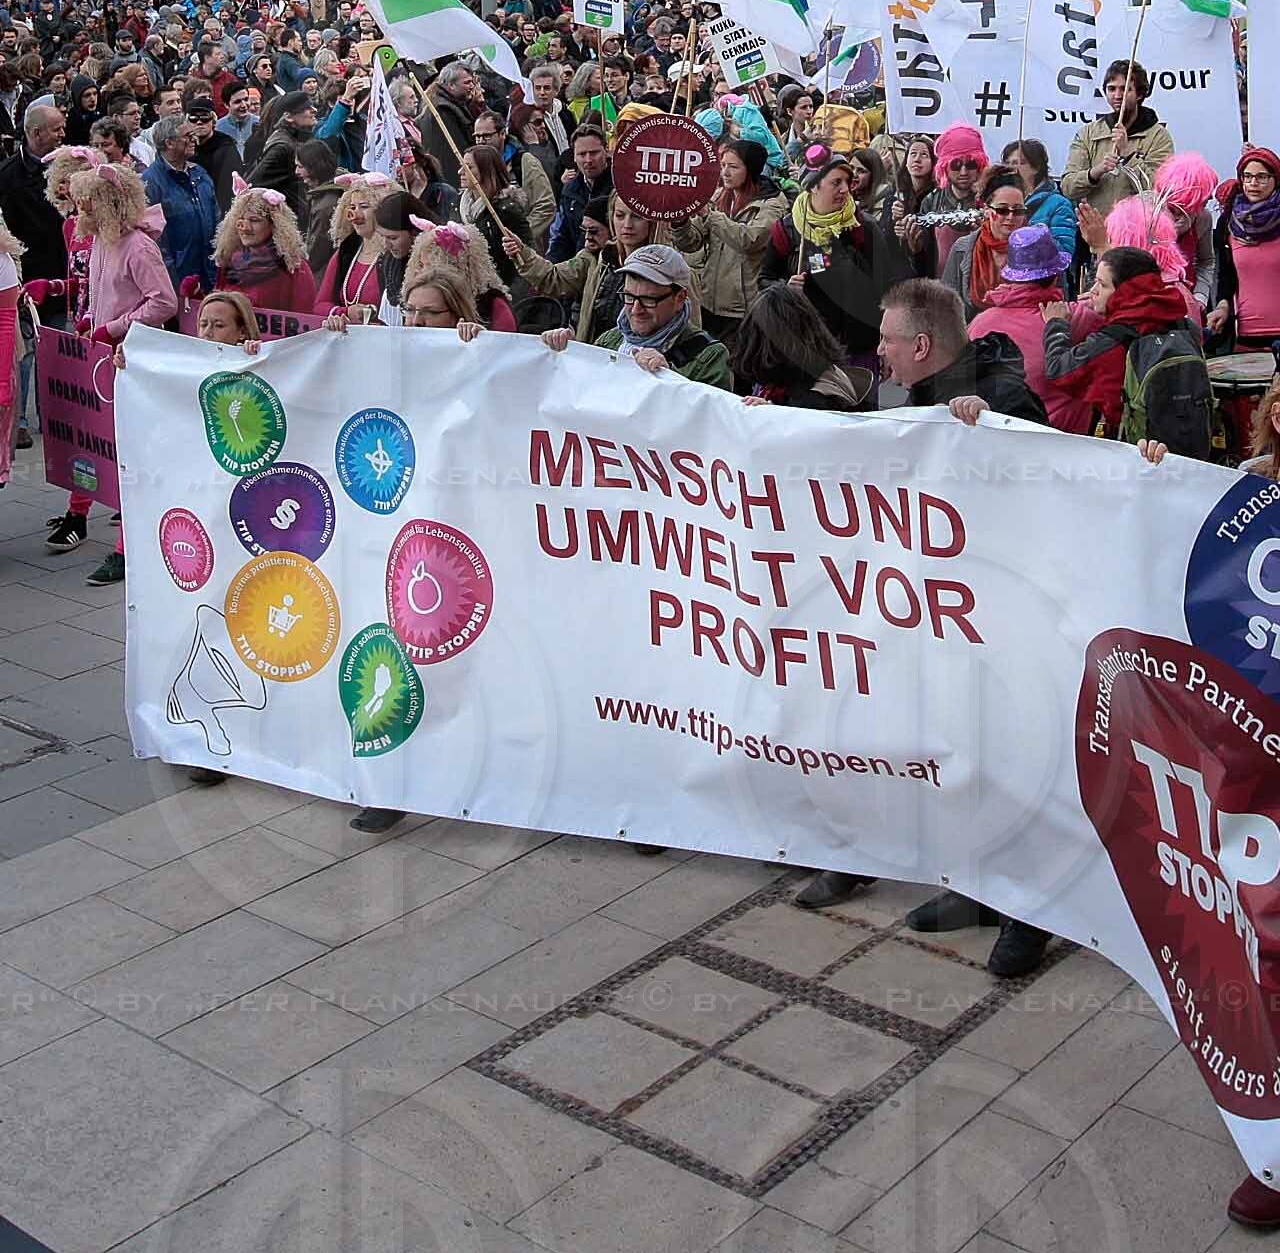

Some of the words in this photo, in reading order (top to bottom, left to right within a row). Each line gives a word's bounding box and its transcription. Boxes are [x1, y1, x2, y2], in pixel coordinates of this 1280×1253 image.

[721, 35, 767, 61] GENMAIS
[723, 27, 753, 45] STAT
[841, 80, 869, 93] TOPPEN
[617, 116, 677, 155] Transatlantische
[677, 120, 718, 164] Partnerschaft
[635, 146, 703, 174] TTIP
[634, 171, 698, 188] STOPPEN
[628, 196, 650, 215] sieht
[651, 209, 685, 219] anders
[686, 198, 701, 214] aus
[259, 307, 311, 335] BER:
[221, 452, 240, 471] TTIP
[240, 440, 281, 473] STOPPEN
[373, 499, 392, 511] TTIP
[391, 466, 412, 508] STOPPEN
[529, 429, 785, 531] MENSCH
[807, 479, 966, 559] UND
[236, 518, 254, 546] TTIP
[425, 525, 486, 579] Lebensqualität
[535, 503, 796, 608] UMWELT
[819, 555, 986, 644] VOR
[229, 575, 252, 616] Konzerne
[249, 557, 299, 579] profitieren
[304, 562, 334, 607] Menschen
[320, 606, 337, 655] verlieren
[404, 642, 434, 659] TTIP
[437, 603, 487, 656] STOPPEN
[649, 588, 878, 696] PROFIT
[236, 634, 257, 664] TTIP
[255, 660, 313, 678] STOPPEN
[343, 645, 360, 684] Umwelt
[404, 690, 421, 725] sichern
[1089, 645, 1178, 757] Transatlantische
[354, 734, 392, 752] PPEN
[594, 695, 942, 788] www.ttip-stoppen.at
[1159, 944, 1206, 1036] sieht
[1200, 1034, 1267, 1099] anders
